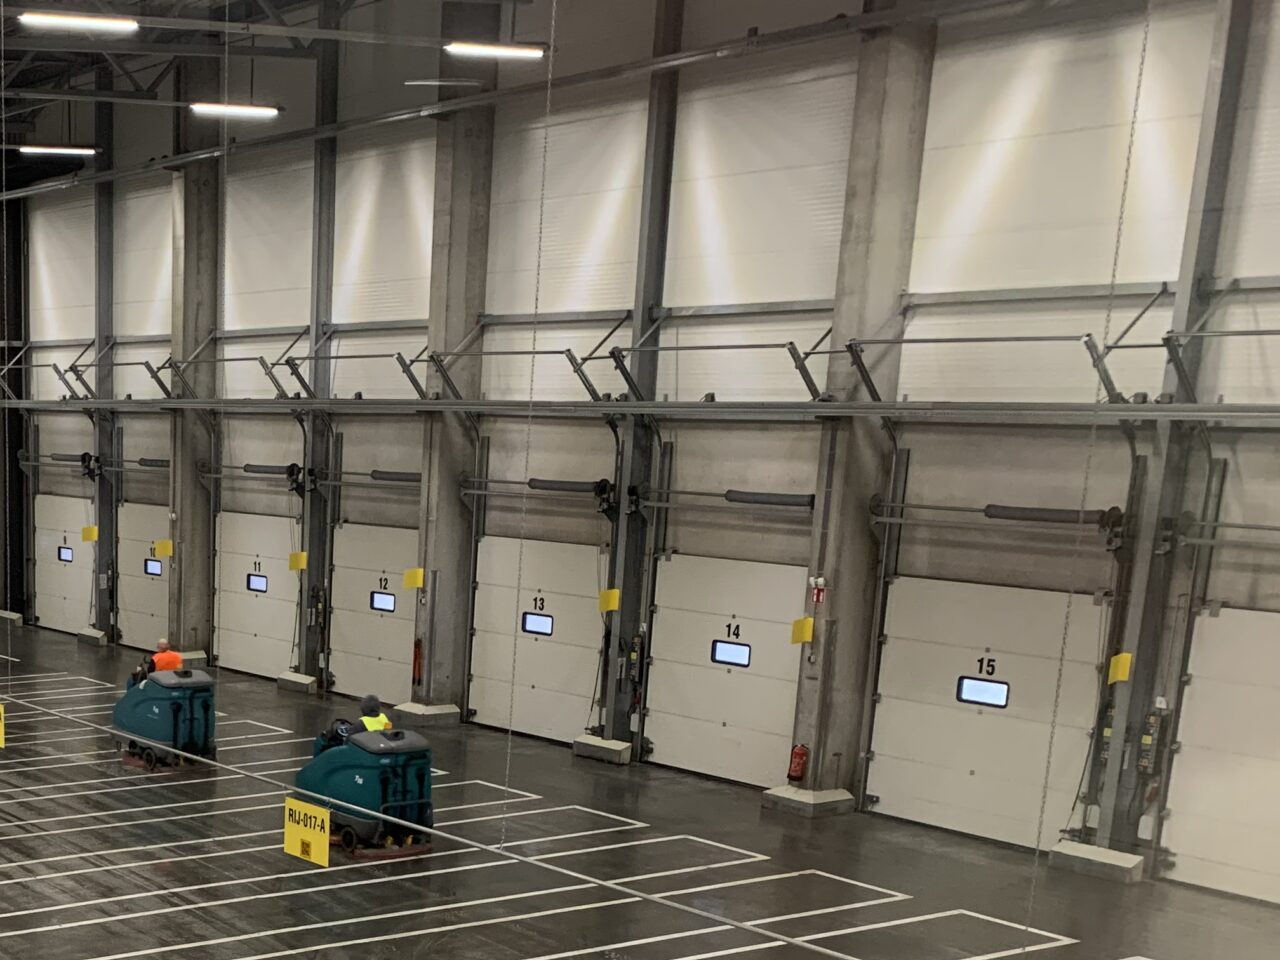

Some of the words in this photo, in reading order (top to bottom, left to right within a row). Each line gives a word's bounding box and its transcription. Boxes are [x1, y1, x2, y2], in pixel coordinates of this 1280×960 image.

[253, 561, 261, 573] 11
[378, 577, 389, 590] 12
[532, 596, 545, 611] 13
[725, 623, 740, 639] 14
[977, 657, 996, 676] 15
[288, 807, 326, 834] RIJ-017-A
